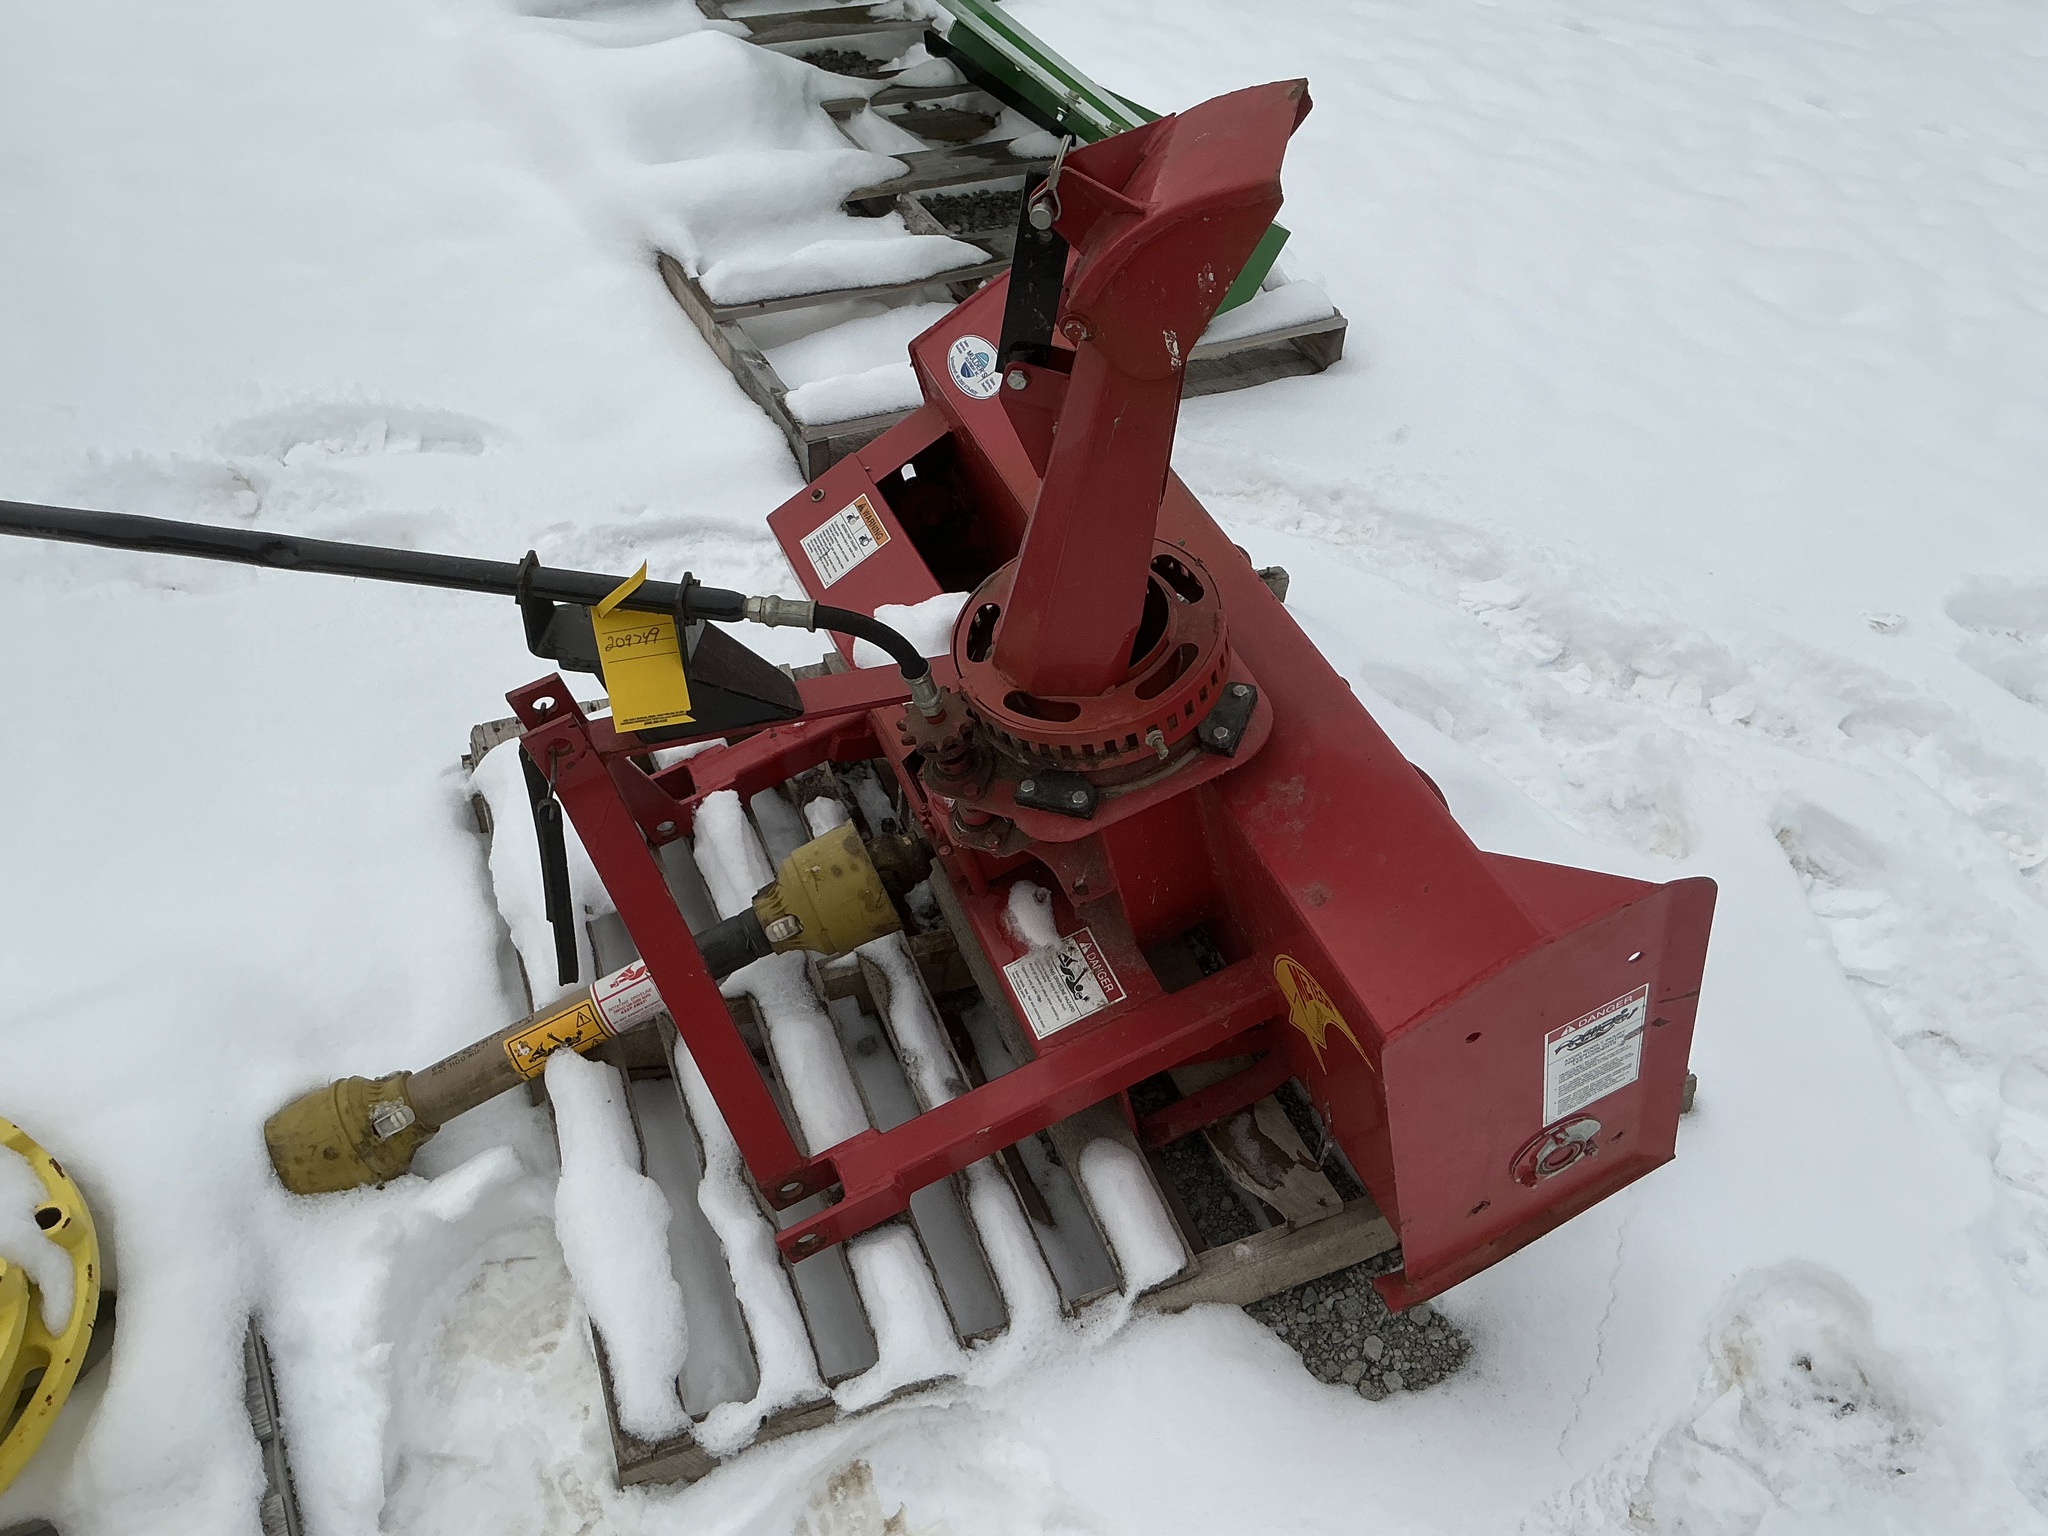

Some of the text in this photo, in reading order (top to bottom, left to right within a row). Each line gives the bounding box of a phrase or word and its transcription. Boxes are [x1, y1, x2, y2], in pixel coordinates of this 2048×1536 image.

[966, 350, 988, 379] MULDER'S
[863, 509, 884, 541] WARNING
[1087, 952, 1114, 993] DANGER
[1063, 995, 1075, 1013] HAZARD
[1578, 995, 1634, 1027] DANGER
